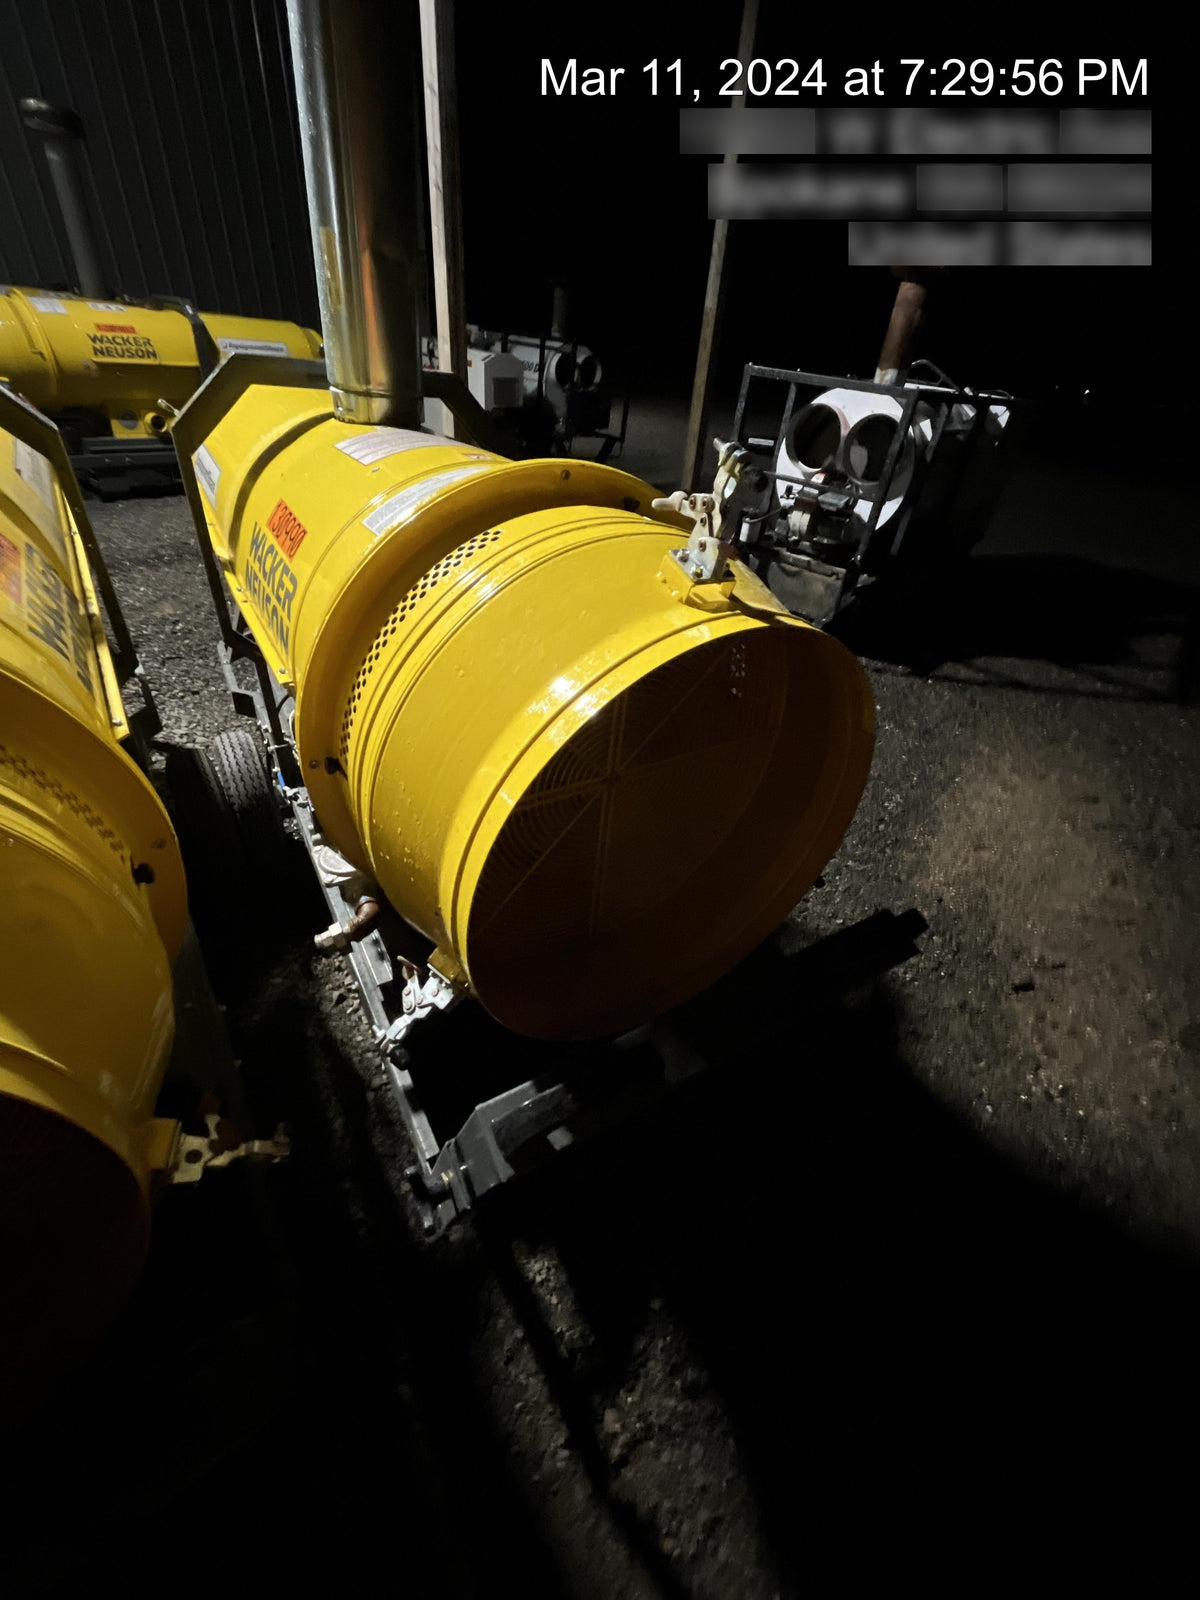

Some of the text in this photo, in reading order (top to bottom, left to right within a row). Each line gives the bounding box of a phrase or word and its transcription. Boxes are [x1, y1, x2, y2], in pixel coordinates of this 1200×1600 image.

[86, 333, 154, 348] WACKER
[92, 345, 158, 360] NEUSON
[249, 521, 298, 623] WACKER
[245, 558, 290, 656] NEUSON
